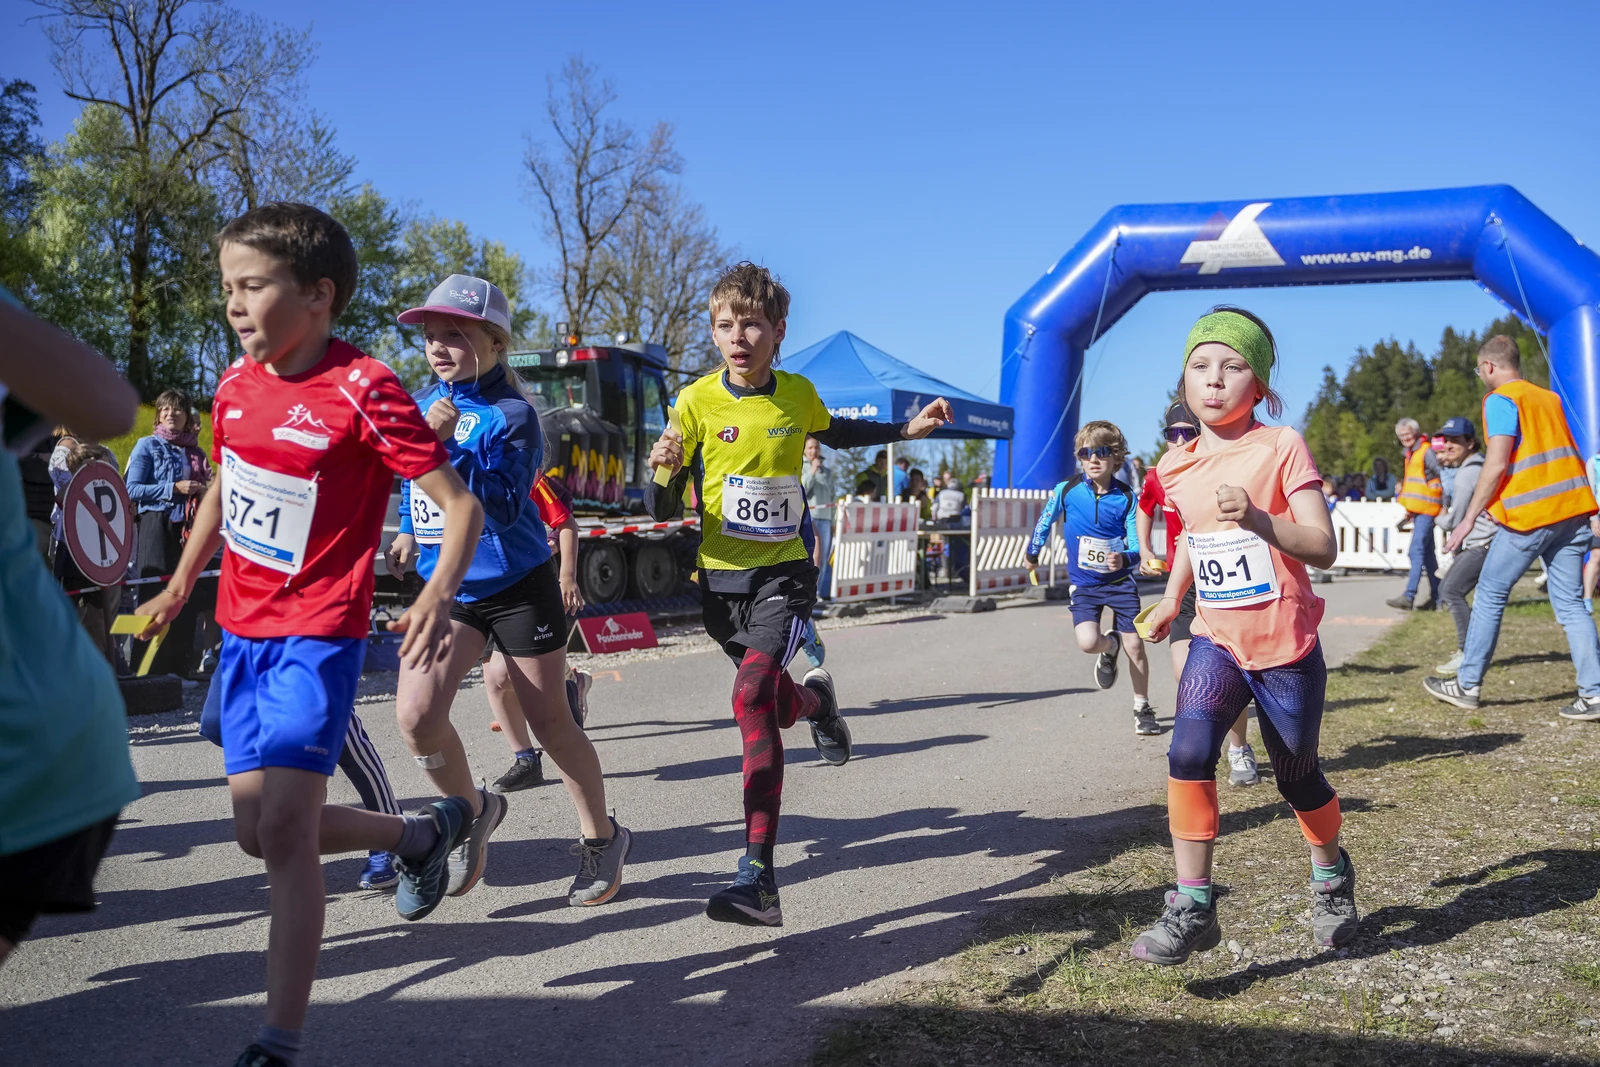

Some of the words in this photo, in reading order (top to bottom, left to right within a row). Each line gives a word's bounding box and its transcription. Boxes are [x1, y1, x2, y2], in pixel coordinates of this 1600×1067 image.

[1300, 246, 1432, 266] www.sv-mg.de
[229, 487, 281, 540] 57-1
[413, 498, 442, 524] 53-
[736, 497, 789, 522] 86-1
[755, 527, 789, 535] Voralpencup
[1087, 550, 1106, 563] 56
[1199, 554, 1252, 586] 49-1
[1217, 588, 1256, 599] Voralpencup
[533, 631, 553, 641] erima
[596, 629, 644, 644] Poschenrieder
